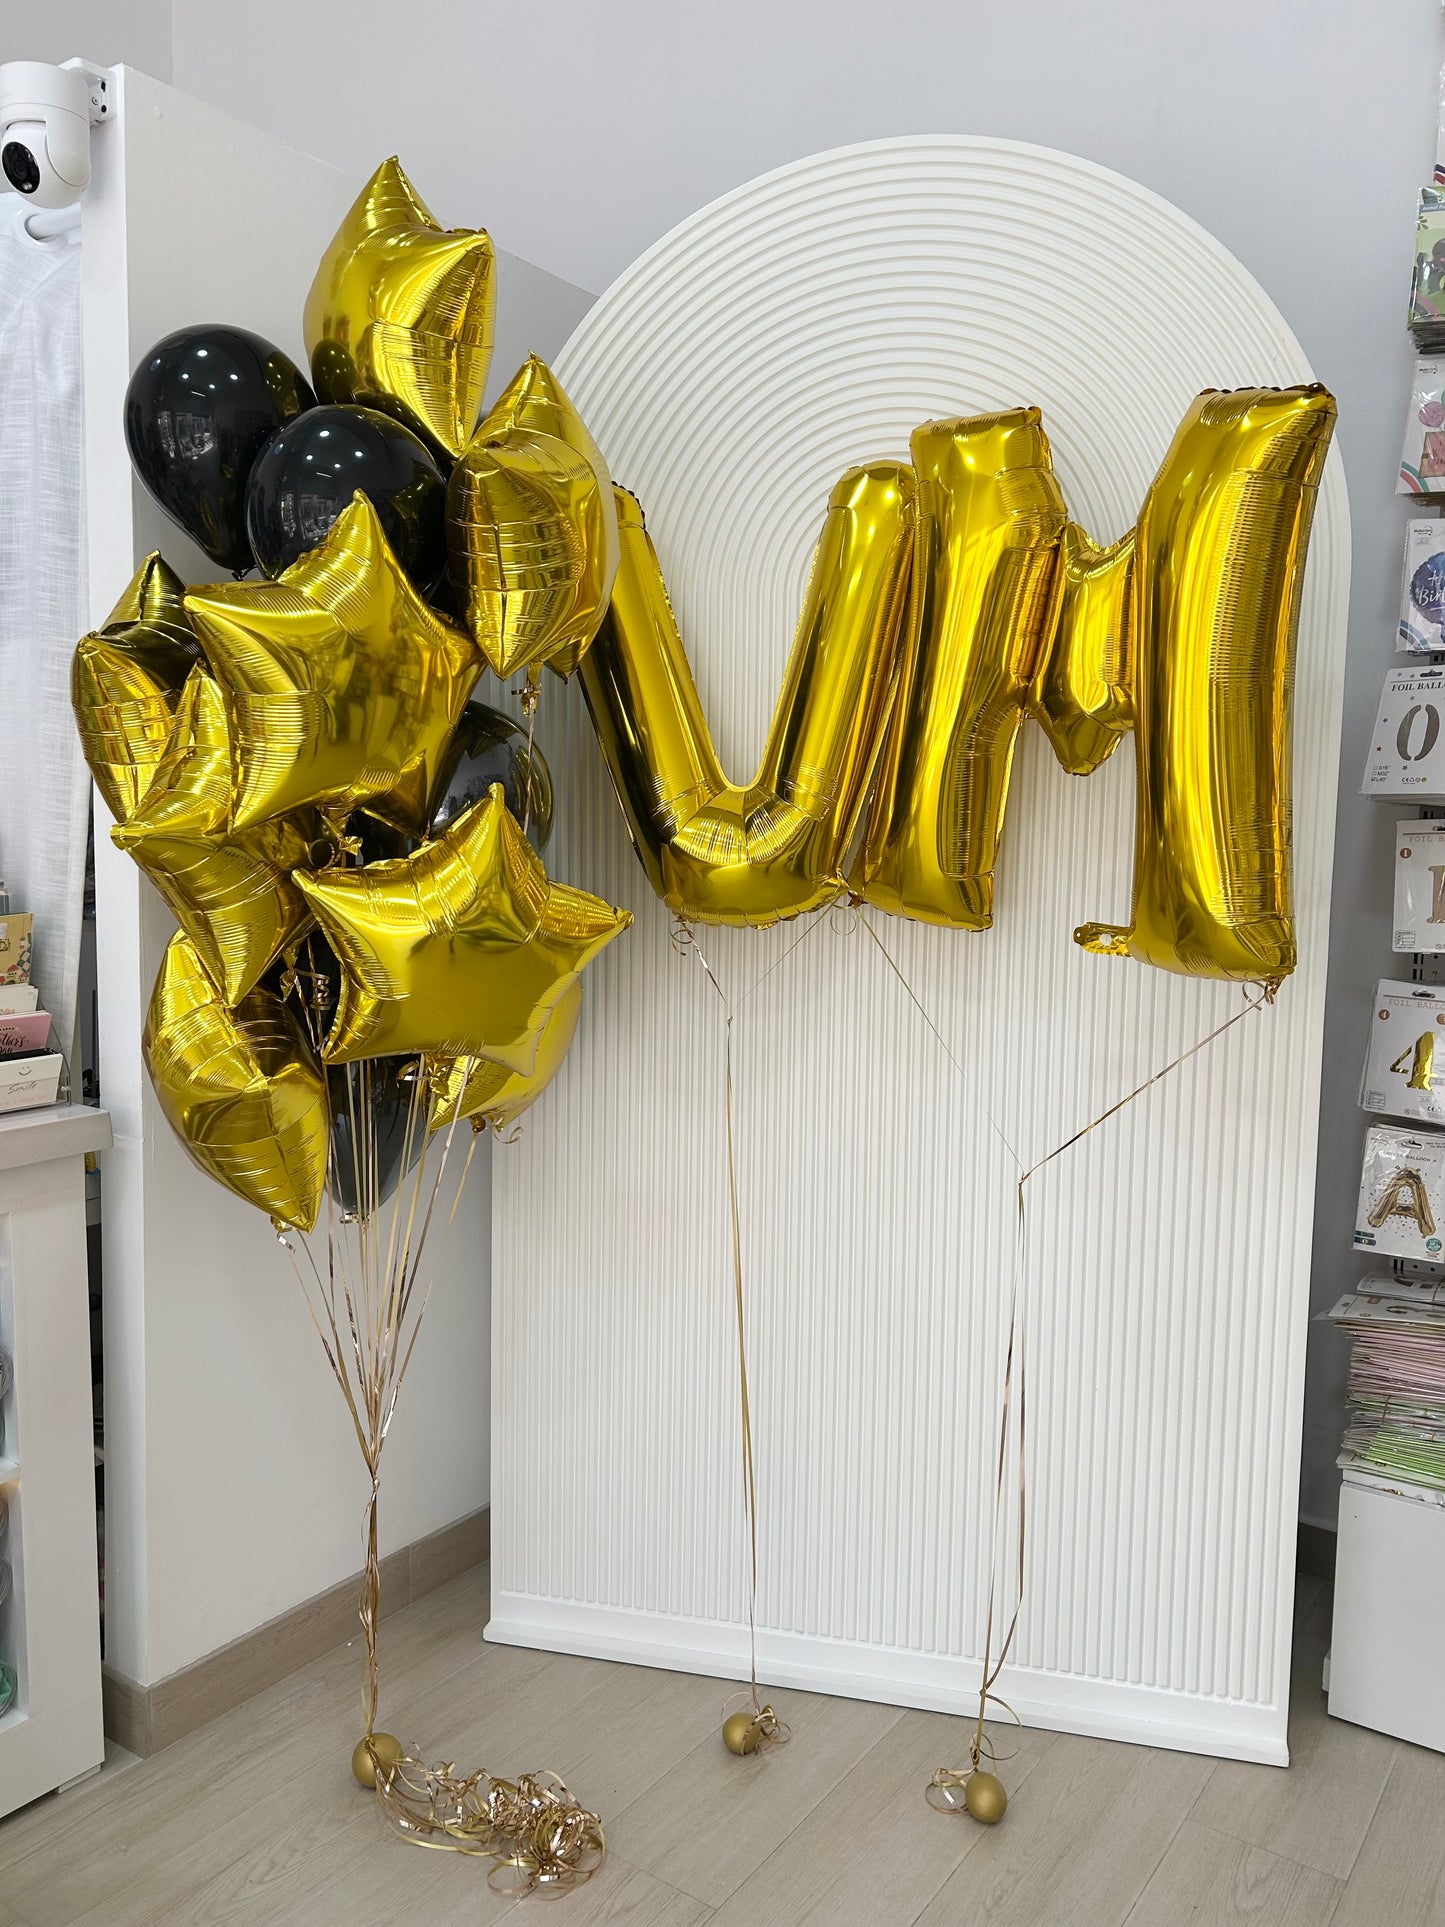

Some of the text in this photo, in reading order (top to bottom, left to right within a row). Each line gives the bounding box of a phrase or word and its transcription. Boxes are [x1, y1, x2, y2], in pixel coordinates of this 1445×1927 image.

[1391, 681, 1445, 692] FOIL BALL
[1409, 835, 1433, 843] FOIL
[1388, 998, 1412, 1007] FOIL
[7, 1081, 38, 1095] Smile
[1405, 1154, 1431, 1162] BALLOON
